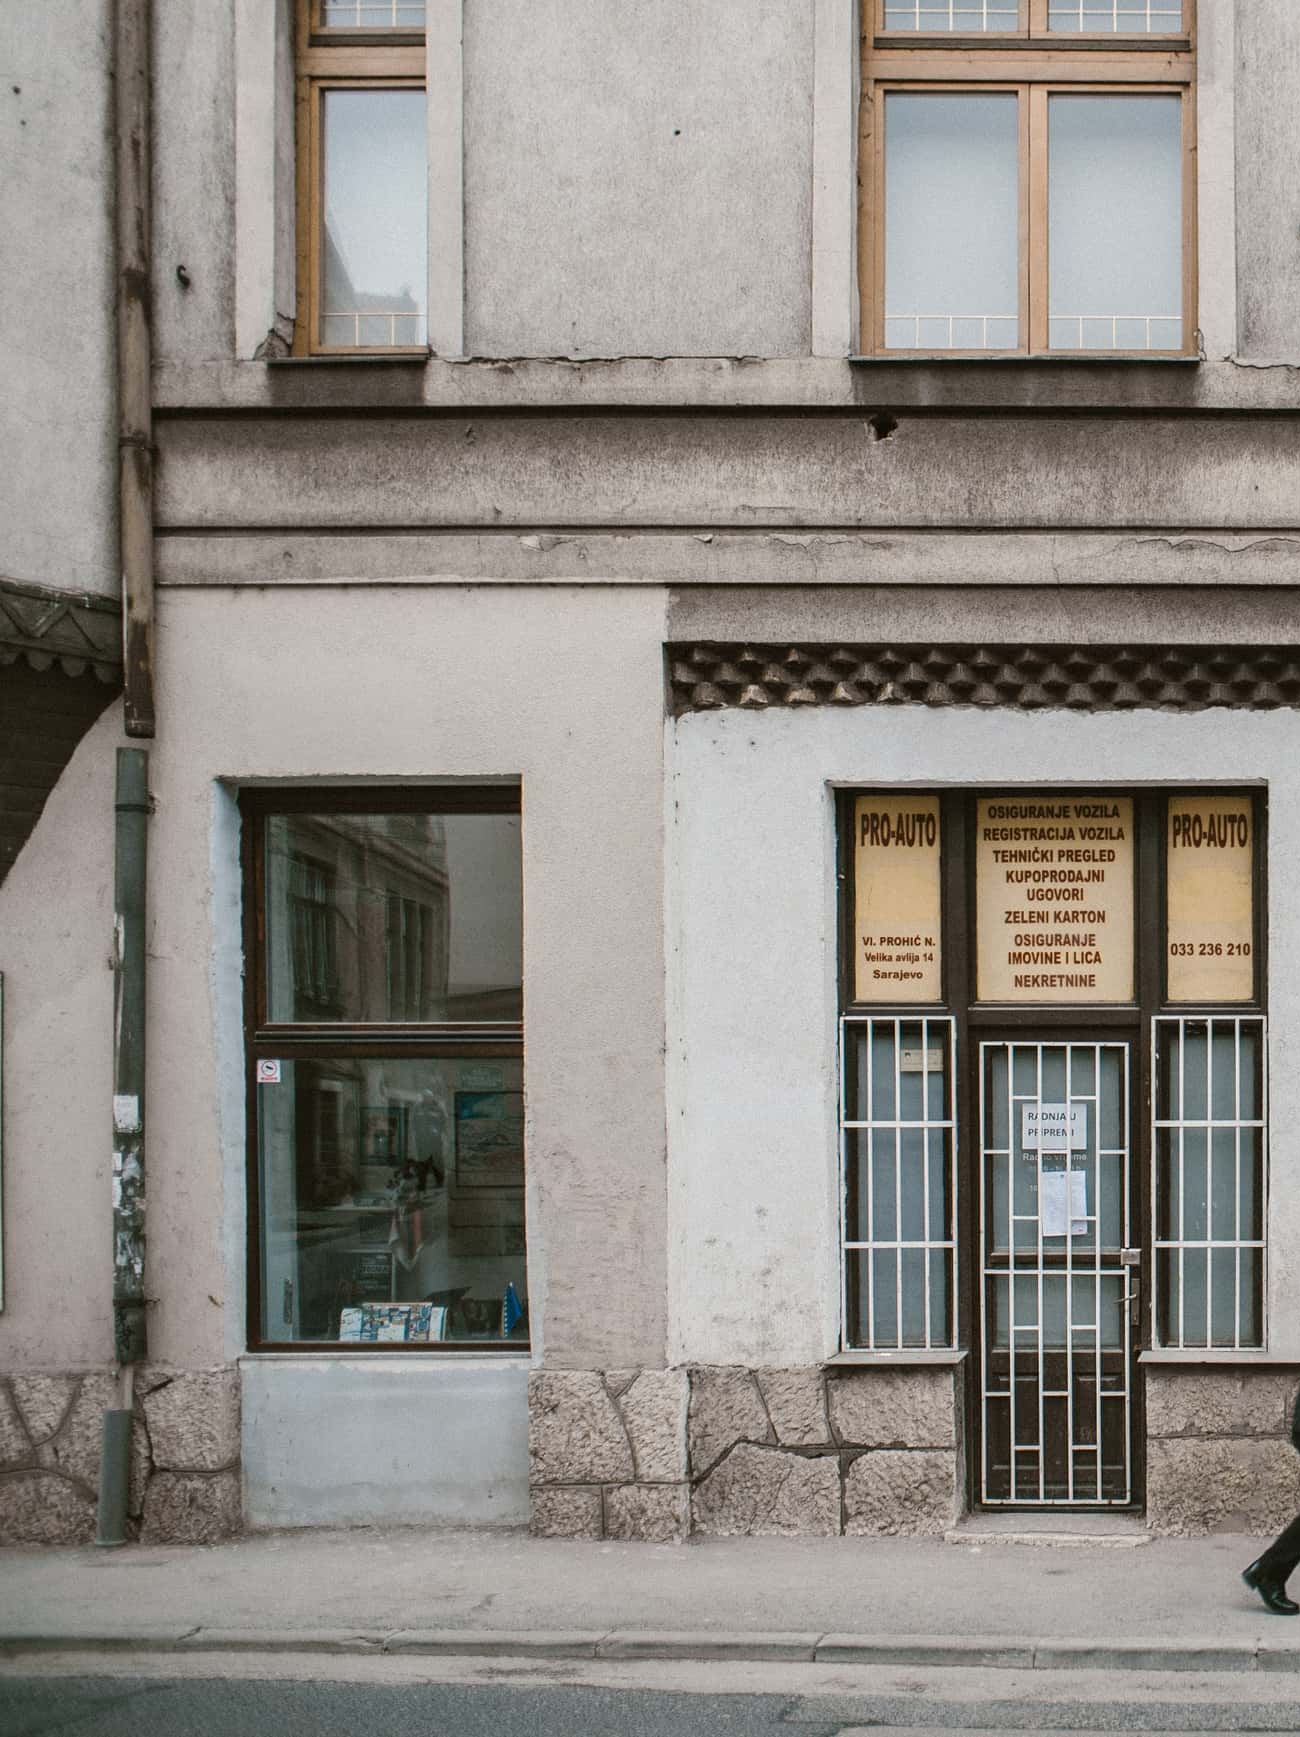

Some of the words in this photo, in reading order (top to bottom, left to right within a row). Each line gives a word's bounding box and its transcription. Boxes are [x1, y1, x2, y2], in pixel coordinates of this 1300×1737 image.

[988, 805, 1070, 819] OSIGURANJE
[1074, 805, 1120, 819] VOZILA
[861, 812, 936, 847] PRO-AUTO
[983, 827, 1075, 841] REGISTRACIJA
[1079, 827, 1125, 841] VOZILA
[1173, 813, 1248, 848] PRO-AUTO
[993, 847, 1053, 863] TEHNIČKI
[1058, 849, 1116, 863] PREGLED
[1006, 870, 1105, 883] KUPOPRODAJNI
[1027, 888, 1084, 901] UGOVORI
[1004, 911, 1049, 924] ZELENI
[1053, 910, 1106, 924] KARTON
[879, 934, 922, 946] PROHIĆ
[924, 937, 936, 946] N.
[1014, 934, 1096, 947] OSIGURANJE
[1170, 943, 1194, 956] 033
[1199, 943, 1222, 956] 236
[1227, 943, 1251, 956] 210
[865, 952, 893, 962] Velika
[895, 952, 920, 964] avlija
[923, 953, 934, 962] 14
[1008, 952, 1062, 964] IMOVINE
[1066, 952, 1069, 964] I
[1073, 951, 1102, 964] LICA
[873, 969, 924, 981] Sarajevo
[1014, 975, 1096, 987] NEKRETNINE
